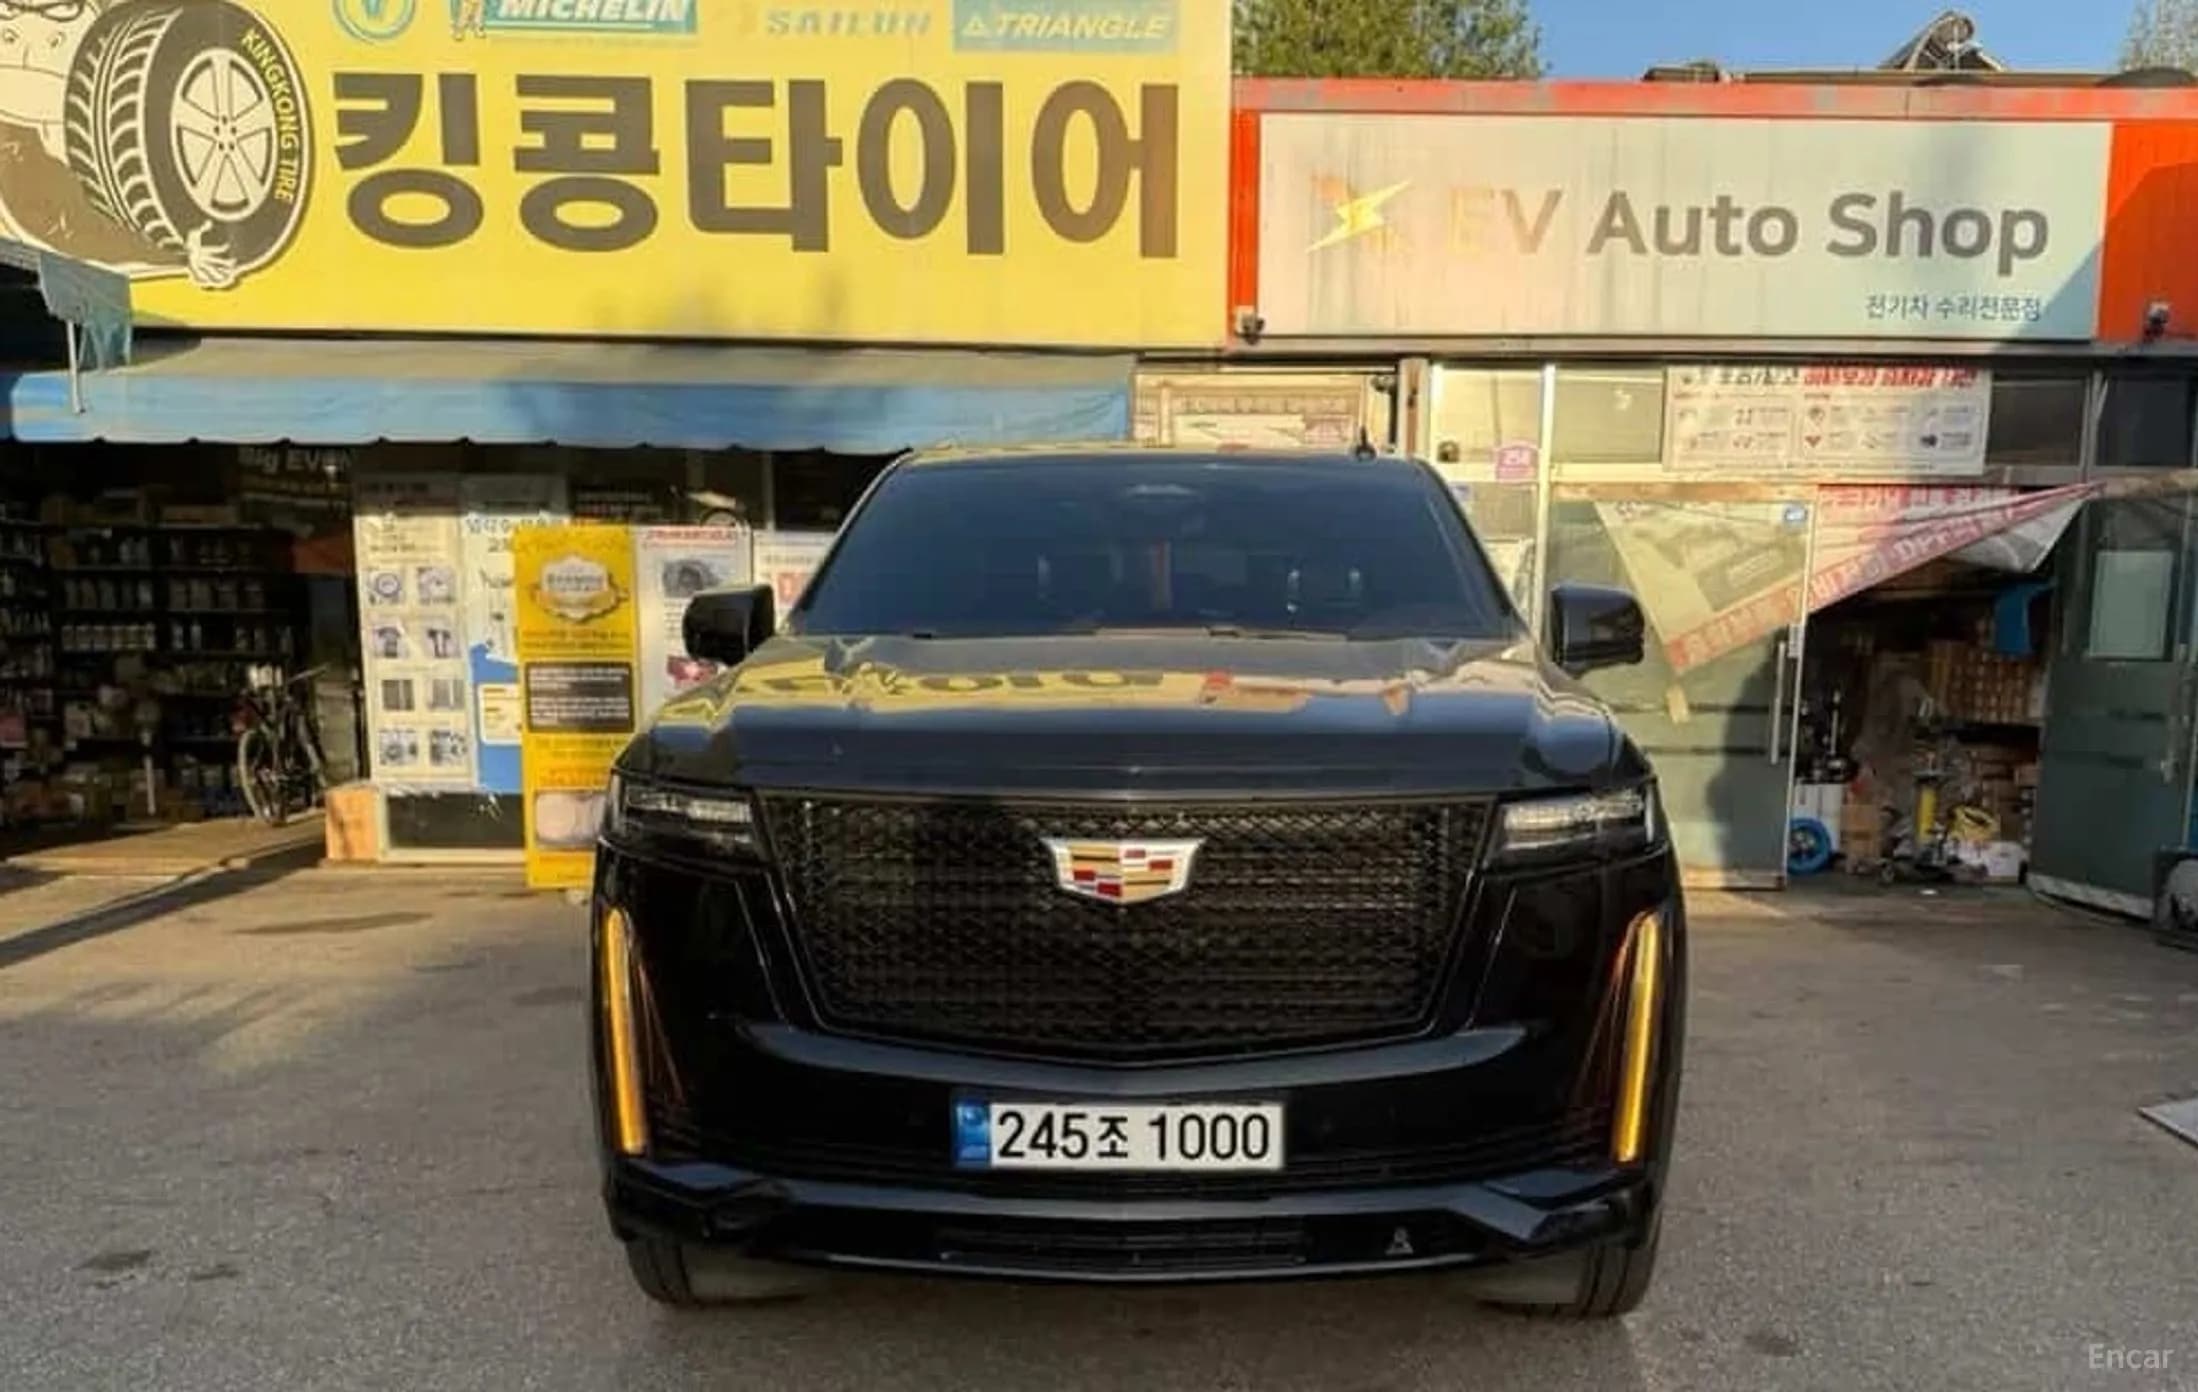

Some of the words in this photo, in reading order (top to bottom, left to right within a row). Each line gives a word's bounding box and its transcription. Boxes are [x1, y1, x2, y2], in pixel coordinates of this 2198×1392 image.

[766, 8, 932, 36] SAILUN
[996, 12, 1171, 41] TRIANGLE
[241, 28, 300, 150] KINGKONG
[273, 159, 300, 204] TIRE
[333, 72, 1179, 259] 킹콩타이어
[1449, 190, 1562, 256] EV
[1587, 191, 1798, 258] Auto
[1827, 189, 2049, 276] Shop
[1865, 293, 1928, 321] 전기차
[1936, 293, 2041, 323] 수리전문점
[997, 1110, 1129, 1160] 245조
[1148, 1112, 1271, 1161] 1000
